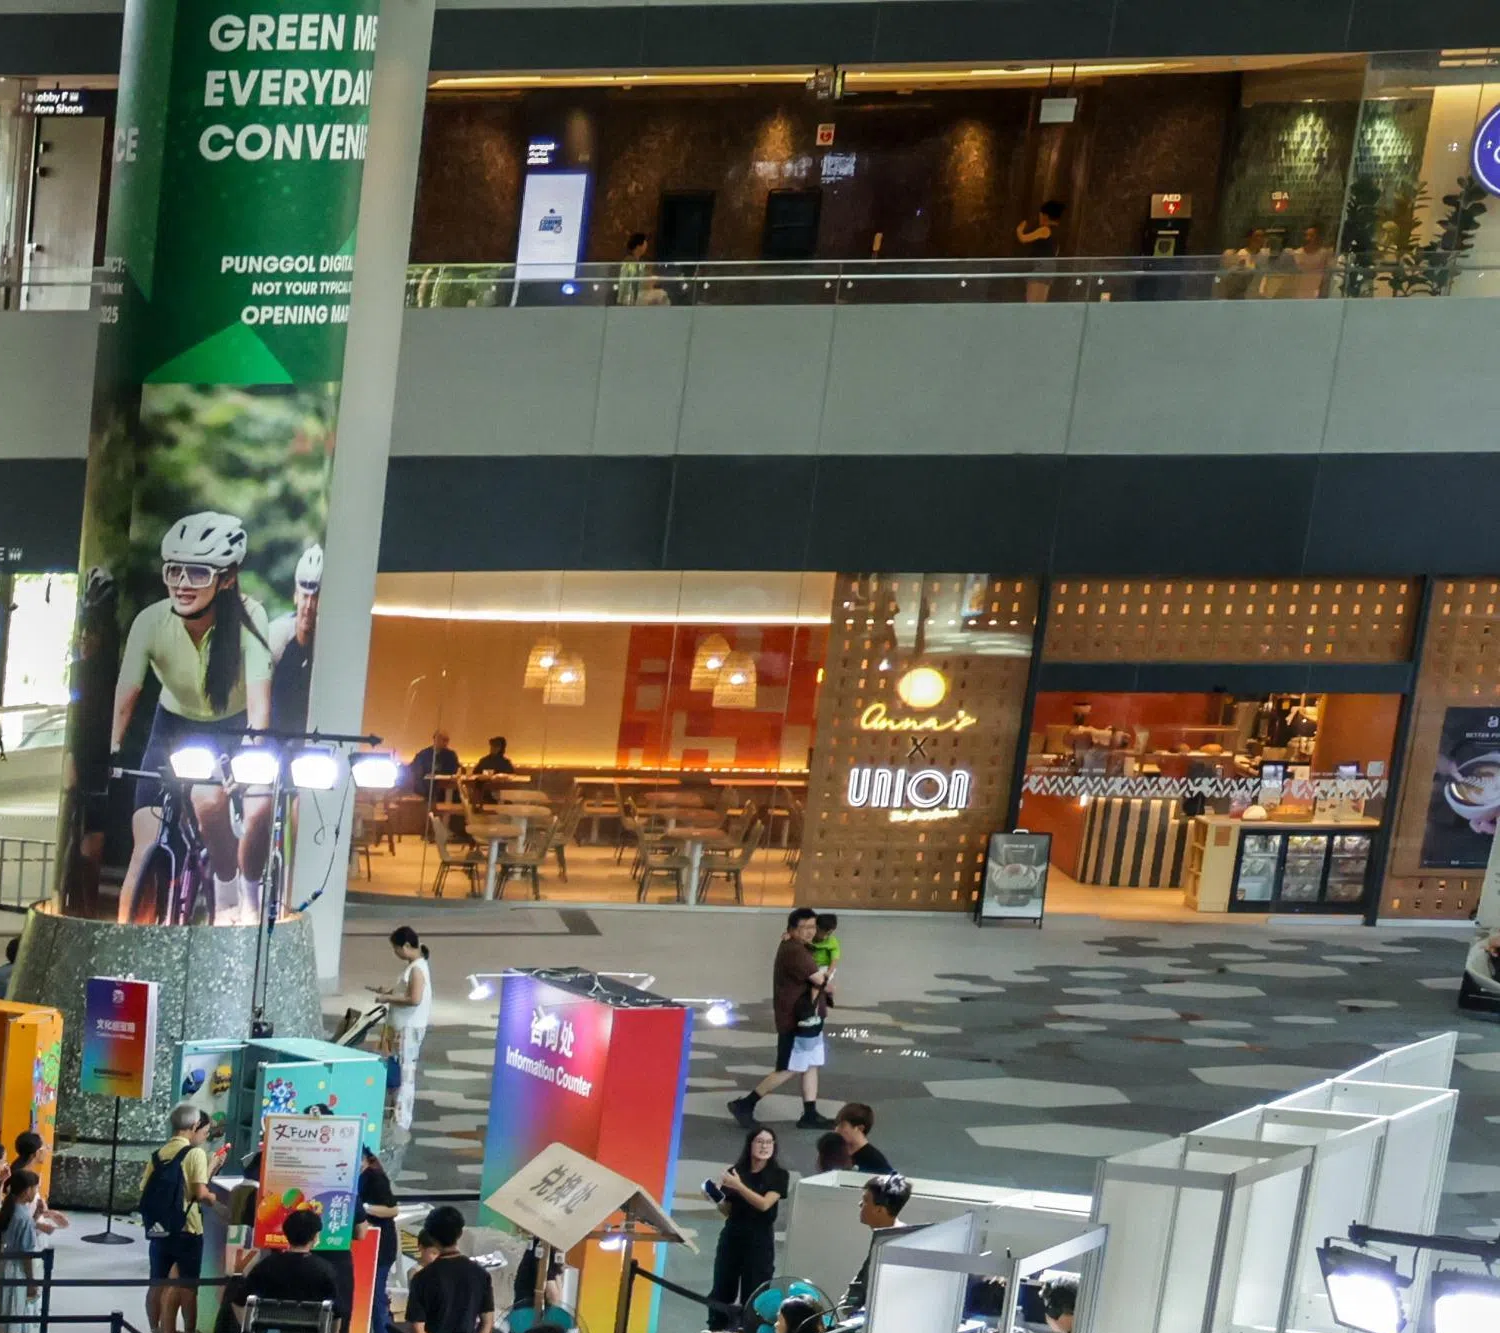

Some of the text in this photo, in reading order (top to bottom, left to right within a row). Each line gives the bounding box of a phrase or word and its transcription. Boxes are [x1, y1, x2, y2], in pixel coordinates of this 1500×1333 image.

[209, 13, 345, 52] GREEN
[204, 69, 373, 107] EVERYDAY
[220, 254, 315, 274] PUNGGOL
[251, 280, 281, 297] NOT
[283, 280, 317, 297] YOUR
[240, 304, 327, 326] OPENING
[859, 702, 978, 733] Anna's
[845, 767, 971, 809] UNION
[506, 1044, 594, 1098] Information Counter
